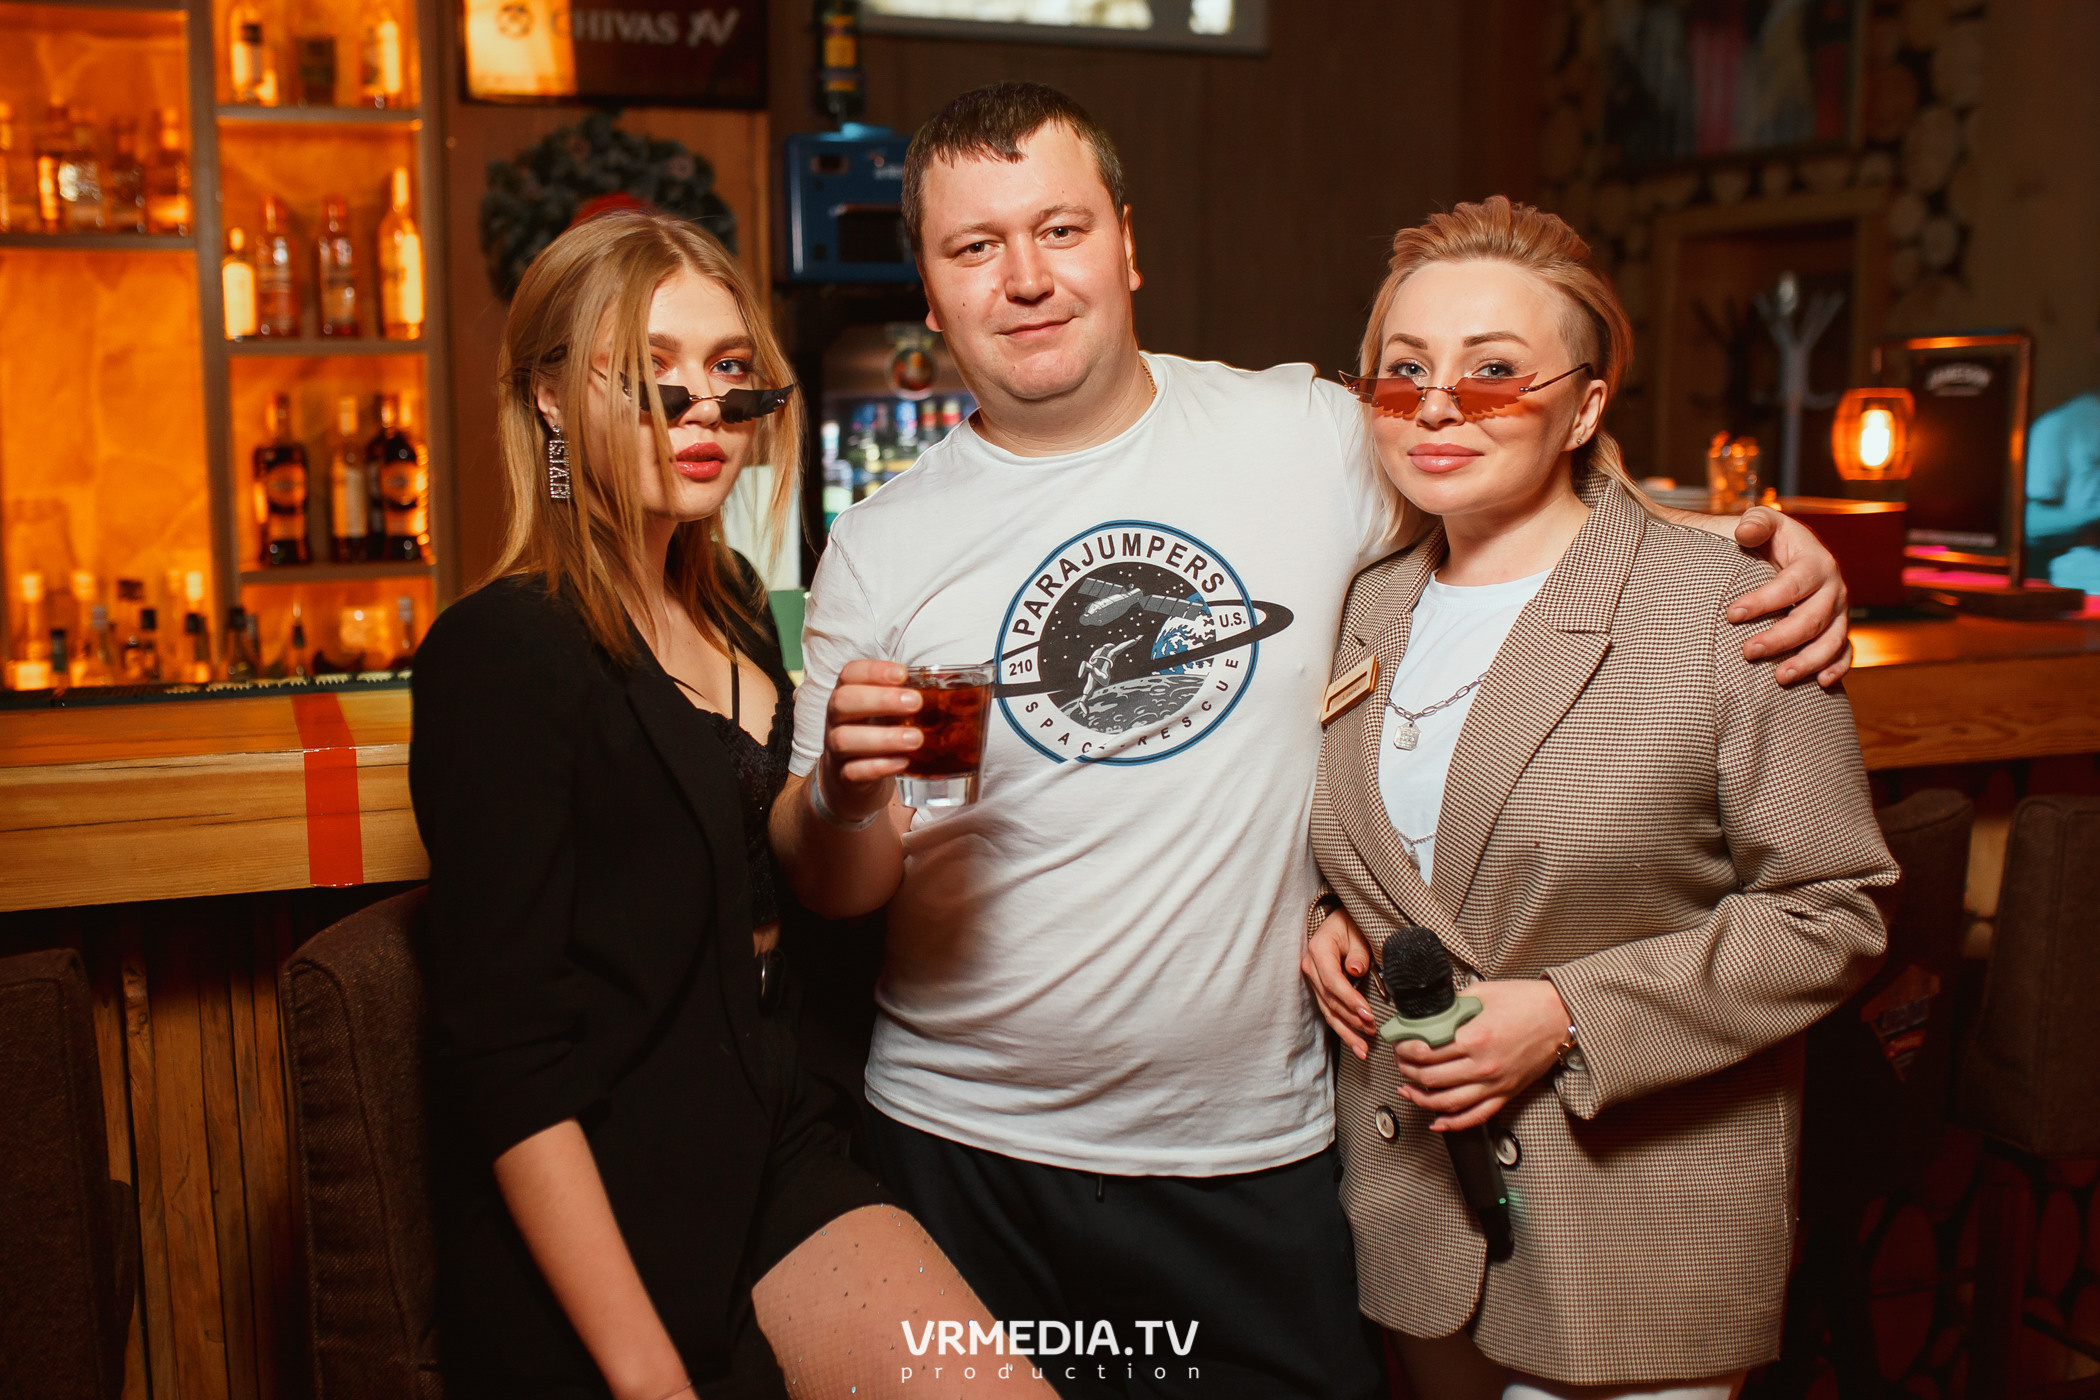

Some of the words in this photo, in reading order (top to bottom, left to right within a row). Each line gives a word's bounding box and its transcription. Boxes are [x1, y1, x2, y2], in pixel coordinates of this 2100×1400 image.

[552, 9, 679, 45] CHIVAS
[1012, 533, 1225, 636] PARAJUMPERS
[1219, 612, 1246, 628] U.S.
[1009, 659, 1033, 676] 210
[1025, 700, 1105, 754] SPAC
[1137, 658, 1239, 746] RESCUE
